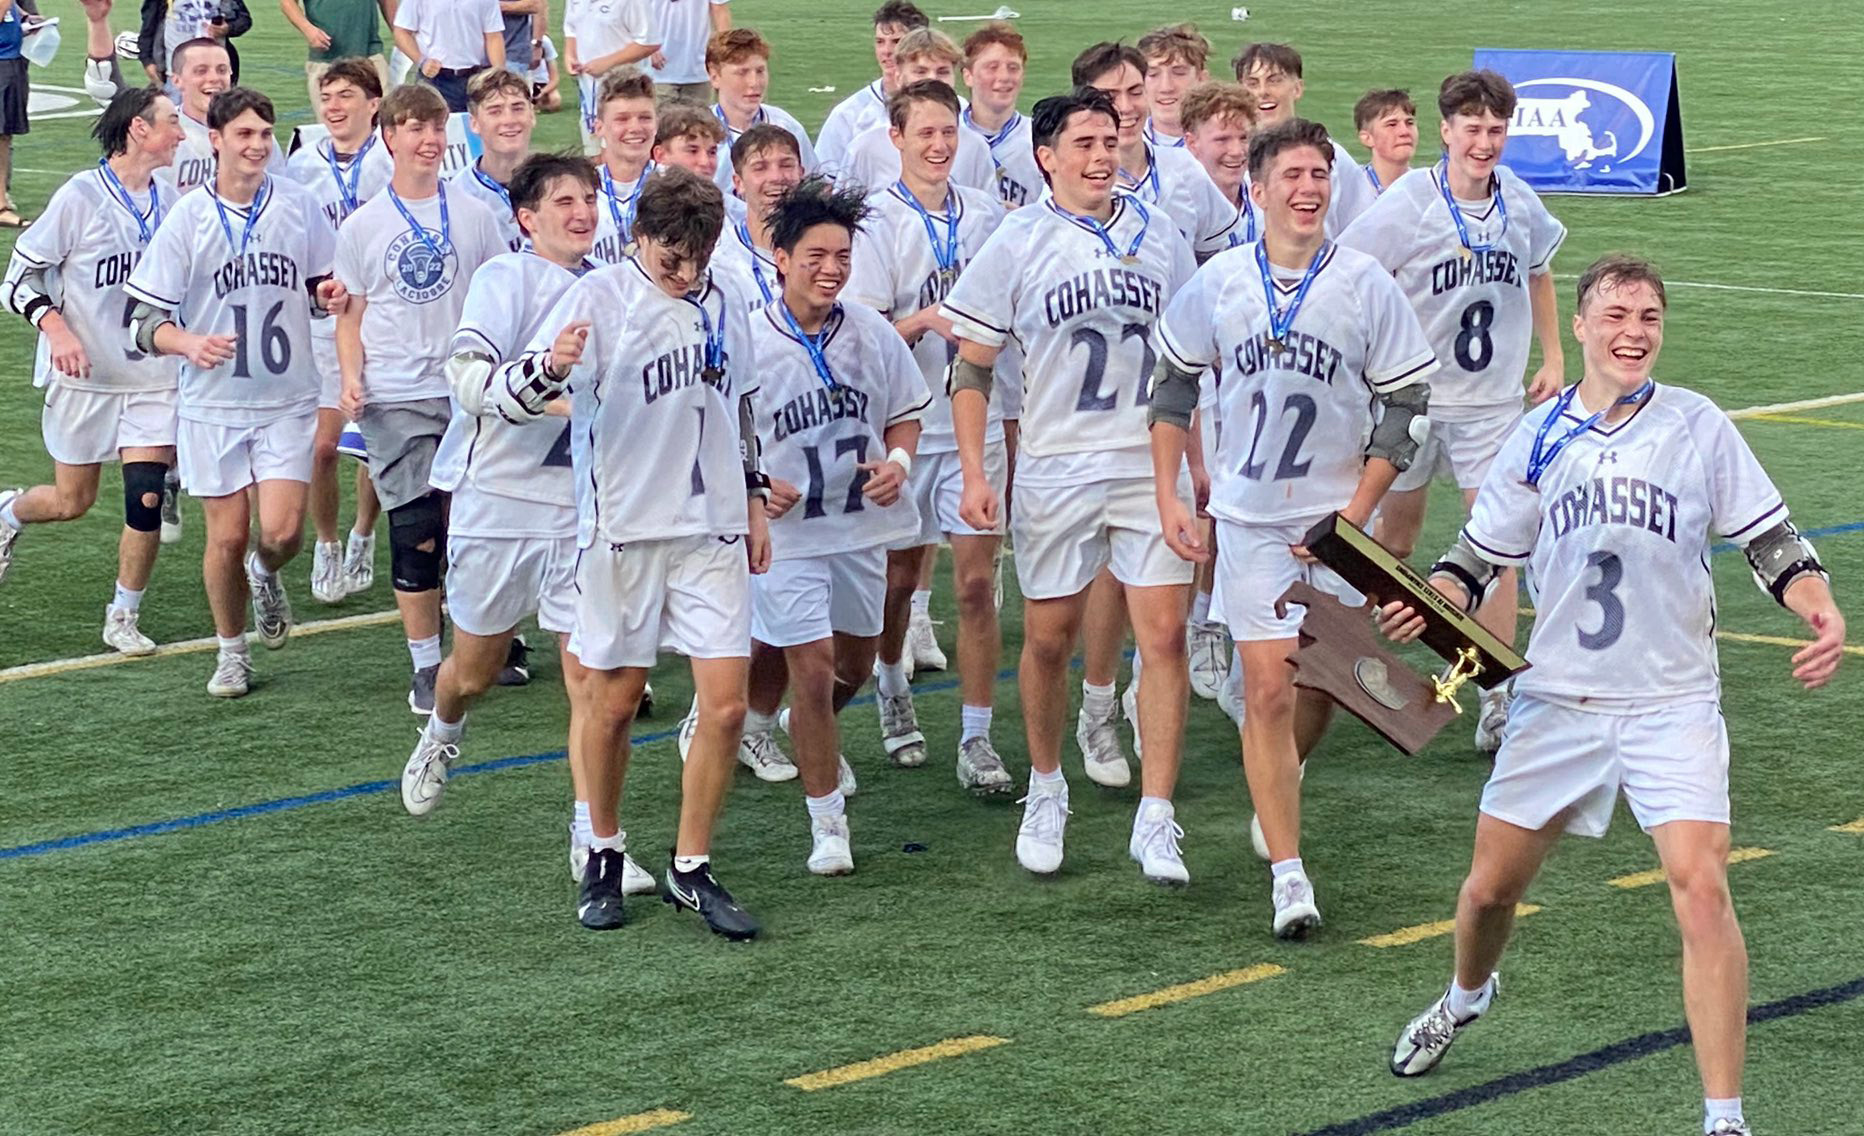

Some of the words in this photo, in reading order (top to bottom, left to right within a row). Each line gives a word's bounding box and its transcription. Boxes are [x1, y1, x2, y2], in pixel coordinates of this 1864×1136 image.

[1508, 107, 1567, 127] IAA
[214, 253, 298, 299] COHASSET
[1045, 268, 1161, 329] COHASSET
[228, 299, 291, 379] 16
[1235, 330, 1342, 387] COHASSET
[1455, 300, 1494, 372] 8
[1238, 389, 1317, 482] 22
[802, 434, 871, 519] 17
[1550, 477, 1678, 543] COHASSET
[1575, 550, 1625, 650] 3
